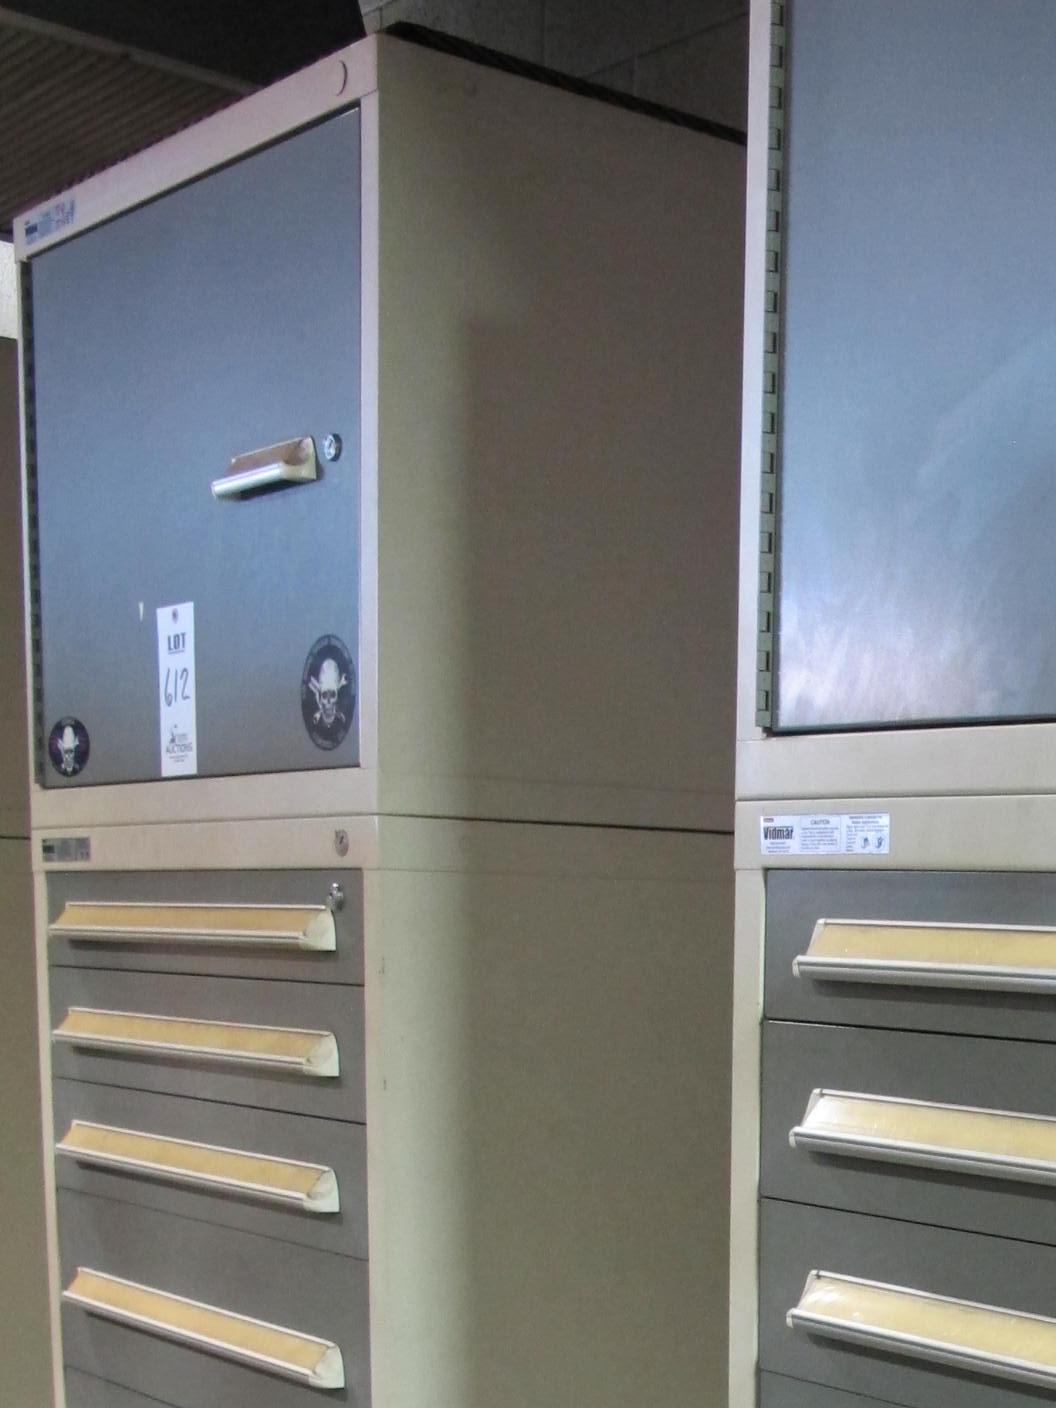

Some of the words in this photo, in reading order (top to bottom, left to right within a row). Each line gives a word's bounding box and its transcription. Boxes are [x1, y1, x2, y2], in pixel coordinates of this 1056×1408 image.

[167, 632, 187, 650] LOT
[164, 667, 191, 707] 612
[763, 825, 793, 840] Vidmar
